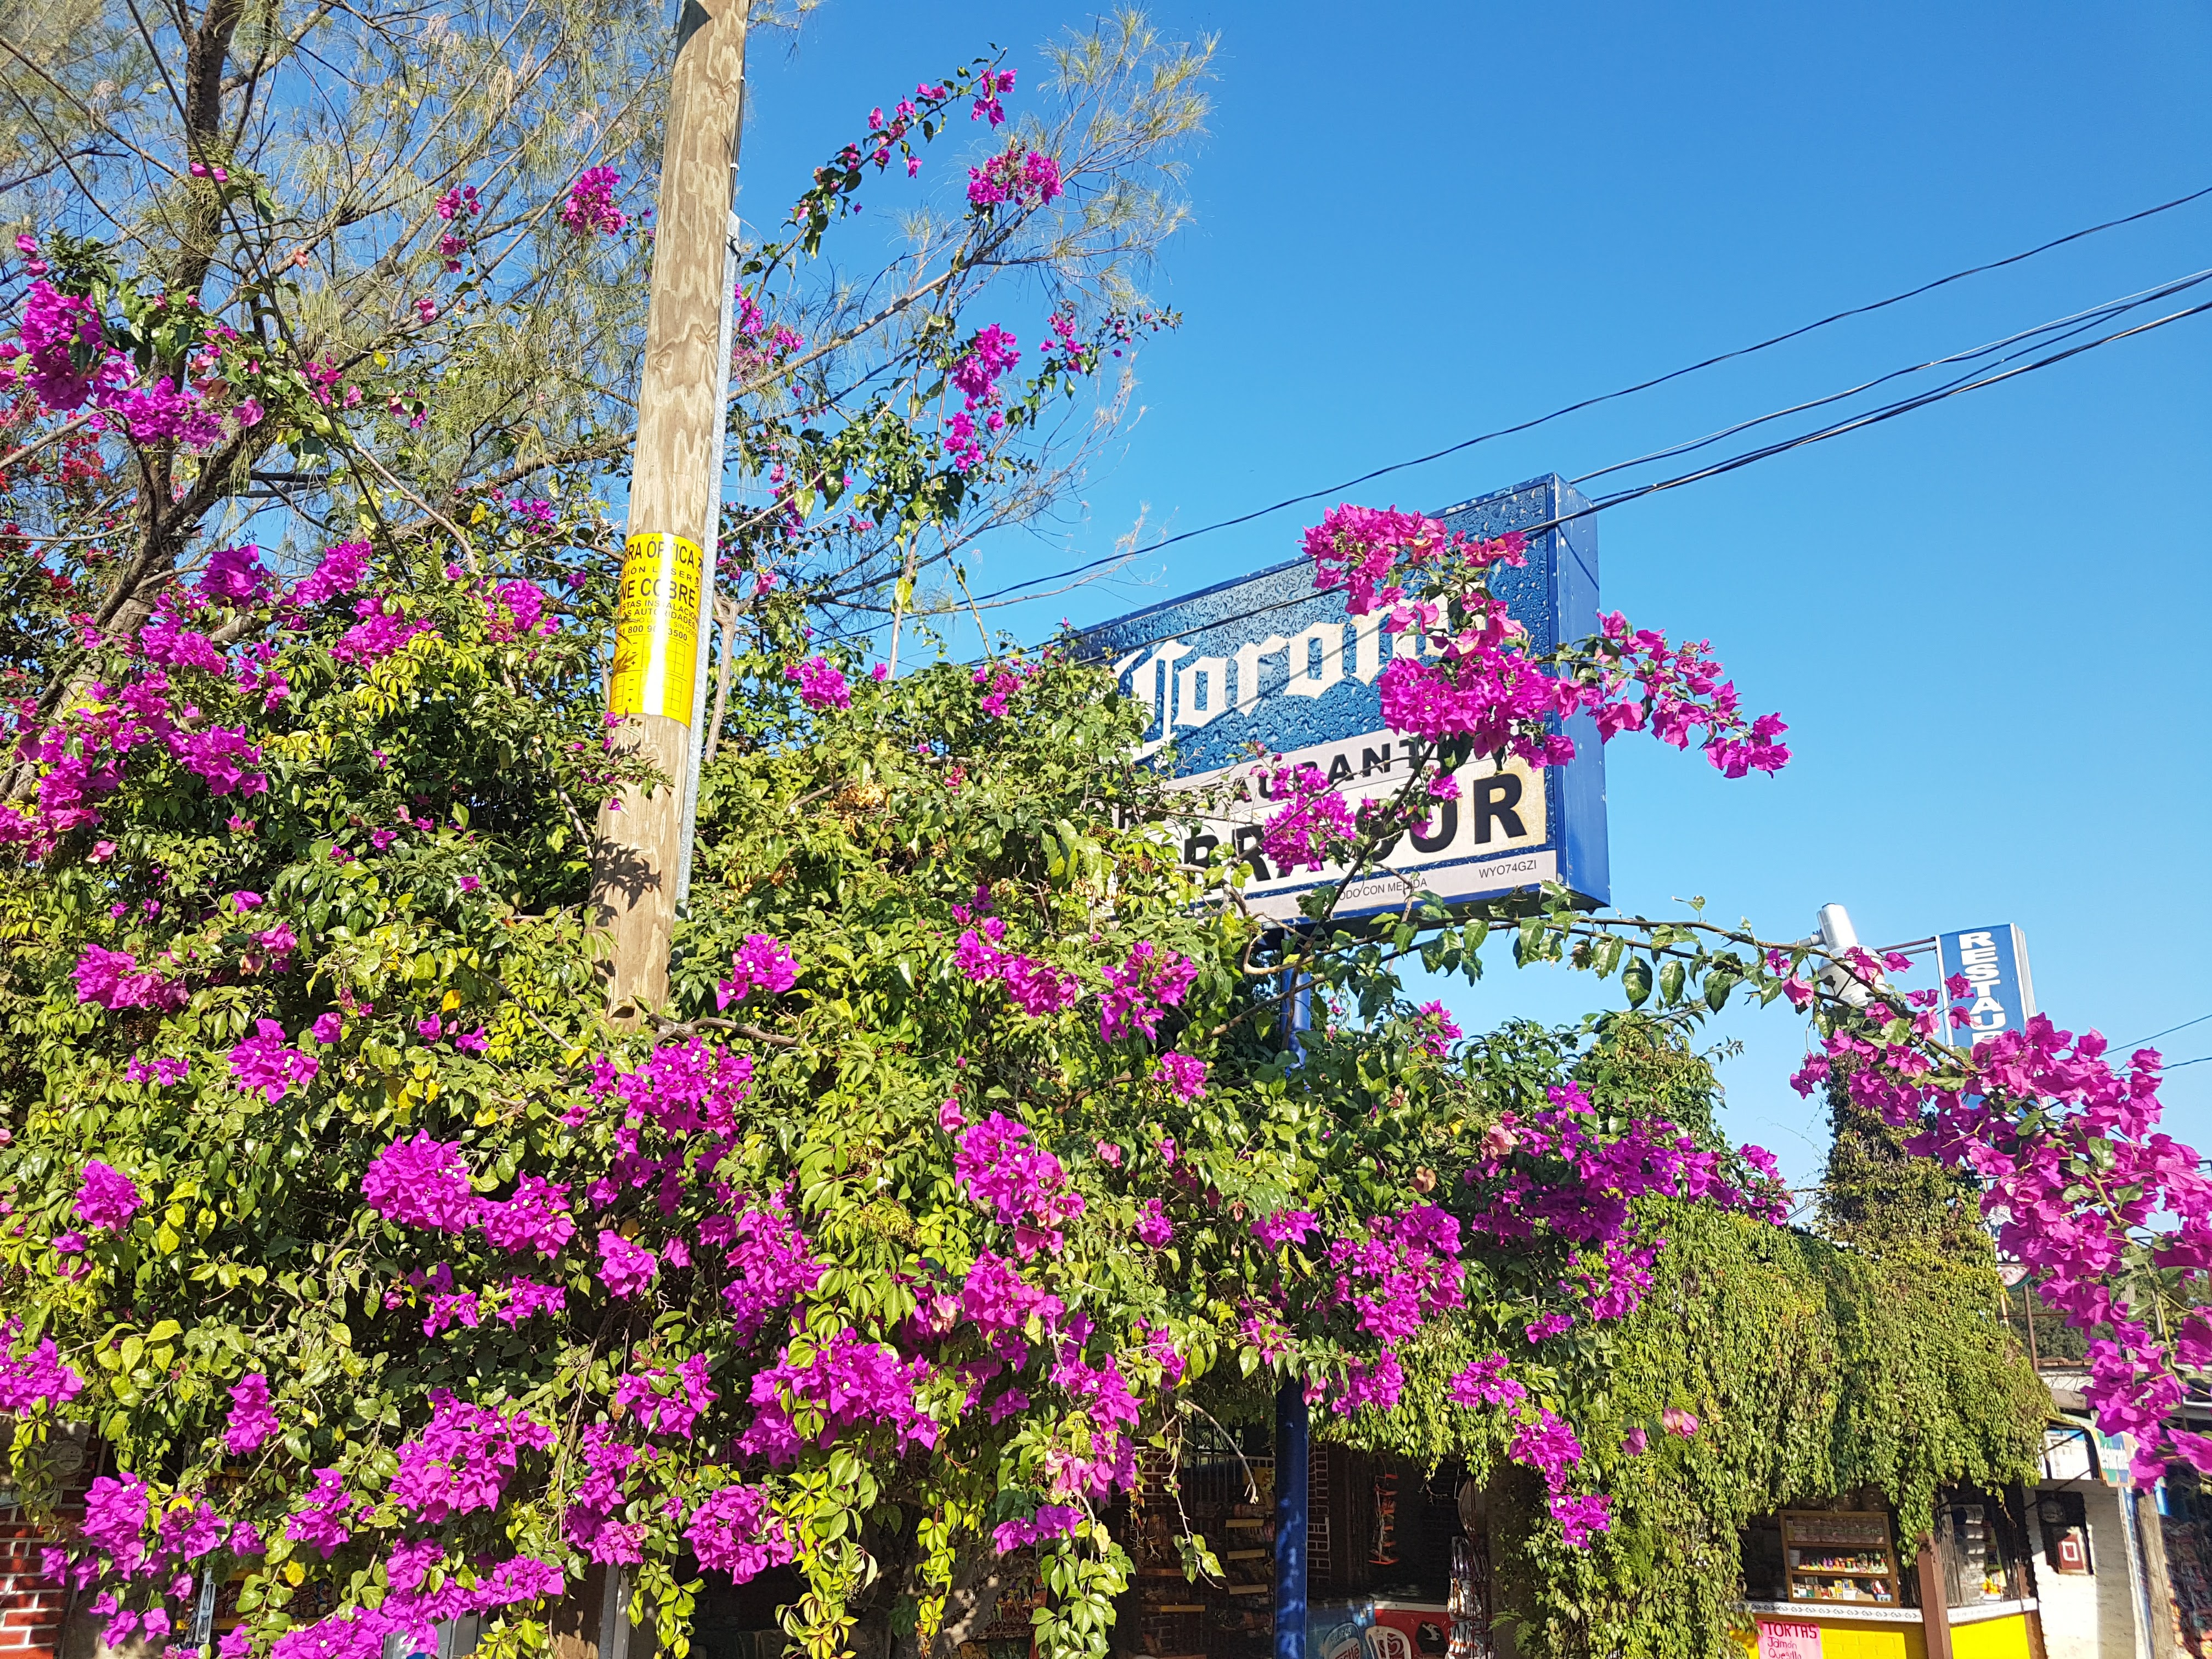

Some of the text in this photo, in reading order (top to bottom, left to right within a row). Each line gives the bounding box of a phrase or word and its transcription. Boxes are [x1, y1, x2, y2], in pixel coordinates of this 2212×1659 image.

[647, 536, 695, 569] ÓPICA
[653, 566, 692, 583] LSER
[628, 625, 644, 634] 800
[668, 628, 687, 641] 3500
[1338, 888, 1360, 901] ODO
[1363, 884, 1385, 896] CON
[1762, 1621, 1817, 1639] TORTAS
